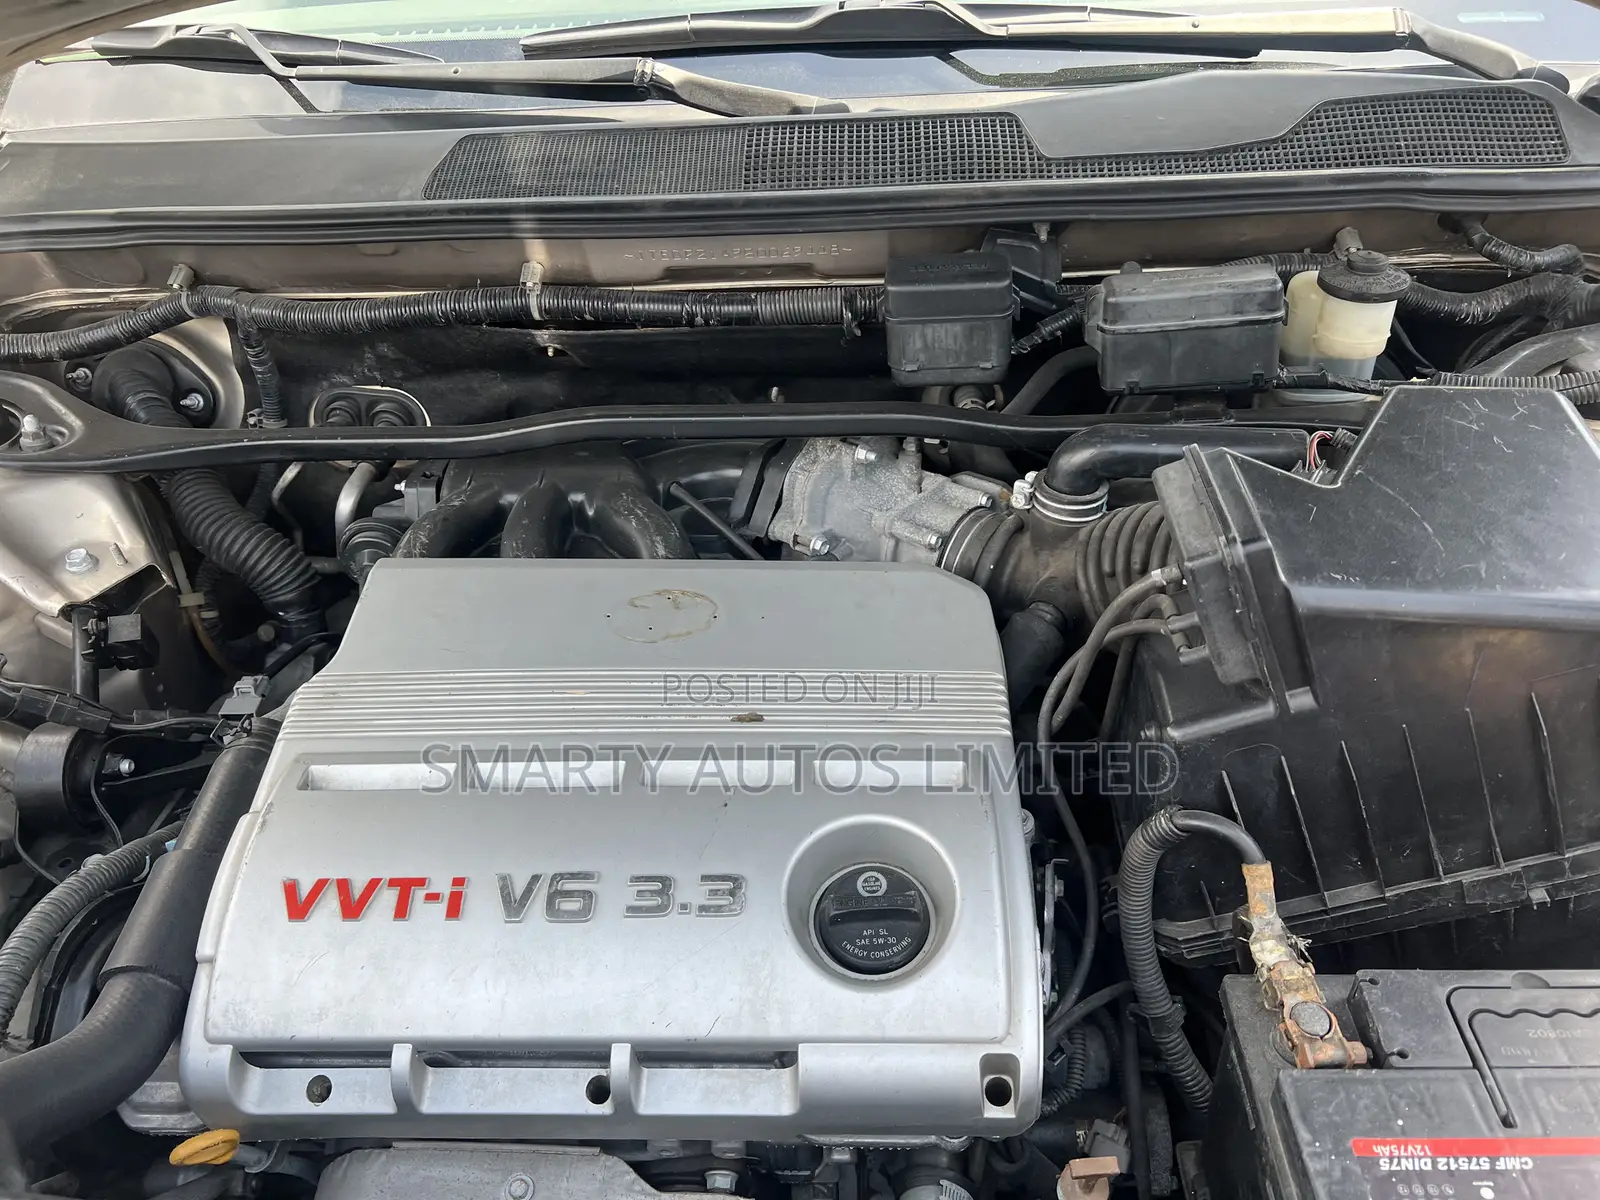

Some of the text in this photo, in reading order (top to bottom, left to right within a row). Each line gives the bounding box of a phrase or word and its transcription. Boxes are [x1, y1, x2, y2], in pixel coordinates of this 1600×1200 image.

[282, 871, 746, 923] VVT-i V6 3.3
[841, 936, 912, 958] ENERGY CONSERVING
[873, 937, 897, 945] 5W-30
[1372, 1144, 1432, 1157] 12V75Ah
[1379, 1156, 1534, 1171] CMF 57512 DIN75
